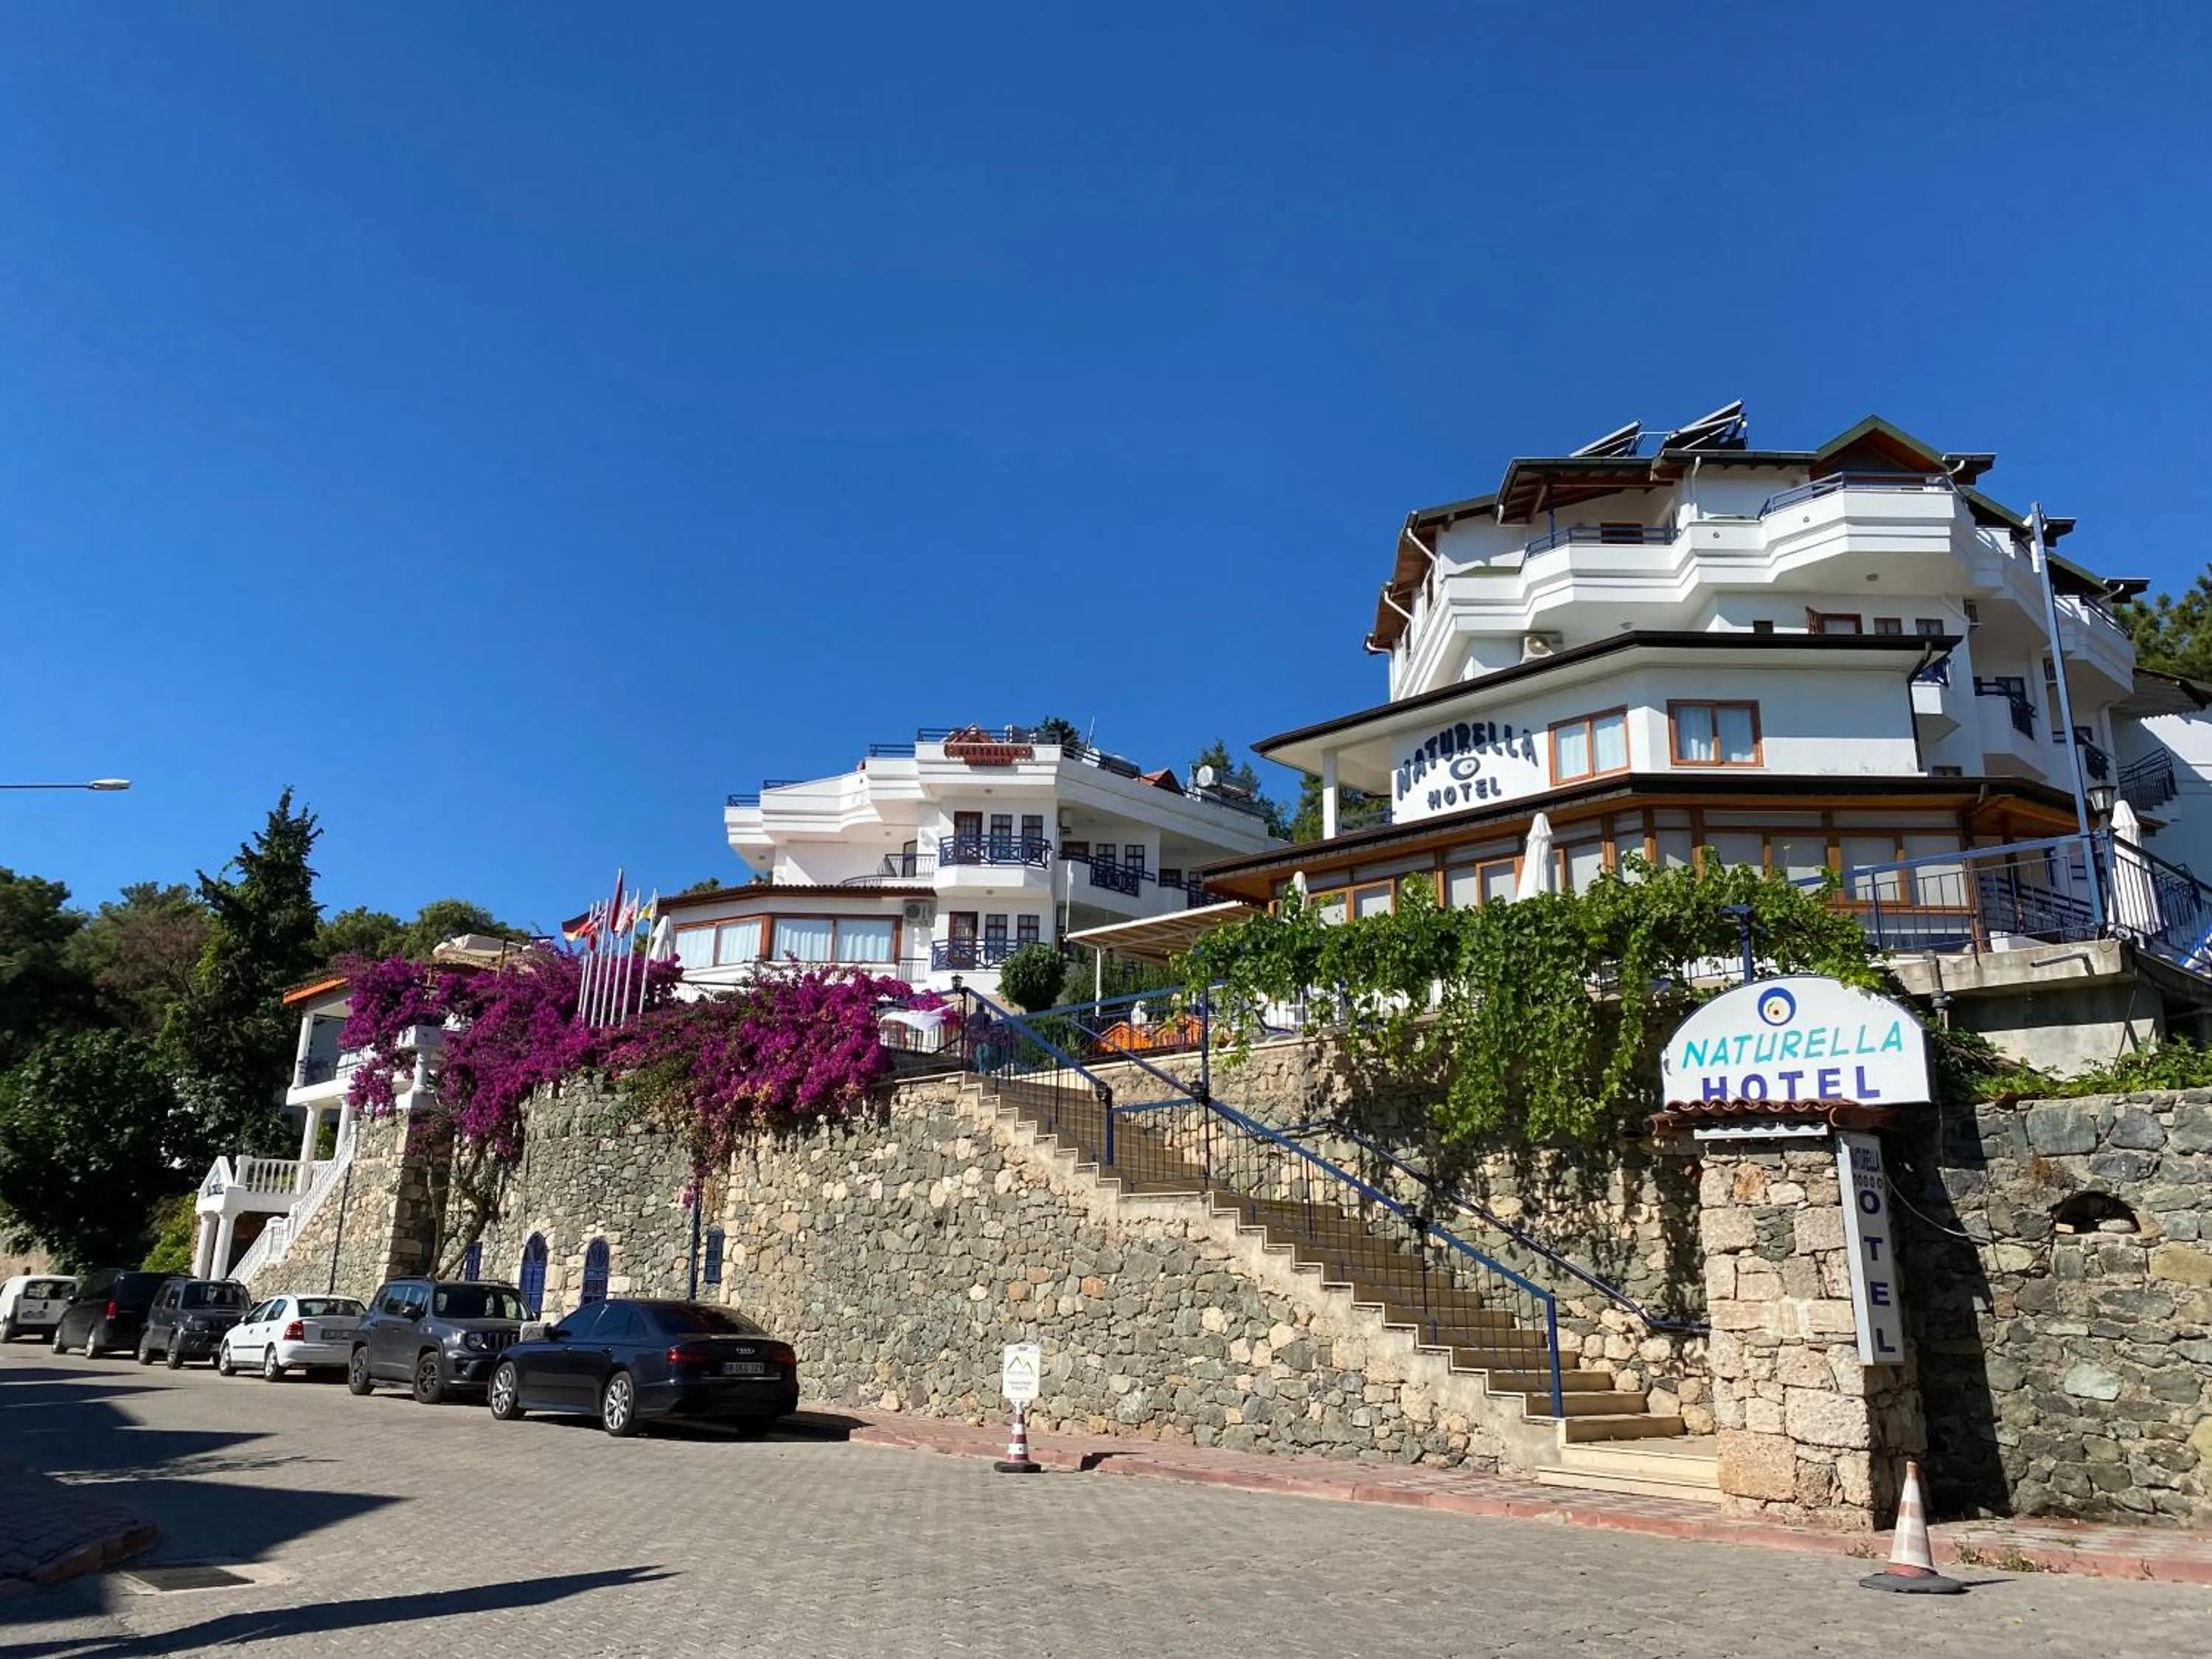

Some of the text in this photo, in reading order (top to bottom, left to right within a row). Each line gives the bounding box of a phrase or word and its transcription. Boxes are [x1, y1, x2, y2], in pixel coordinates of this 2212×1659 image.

[1397, 721, 1538, 801] NATURELLA
[1427, 776, 1501, 810] HOTEL
[1682, 1020, 1903, 1069] NATURELLA
[1702, 1065, 1880, 1102] HOTEL
